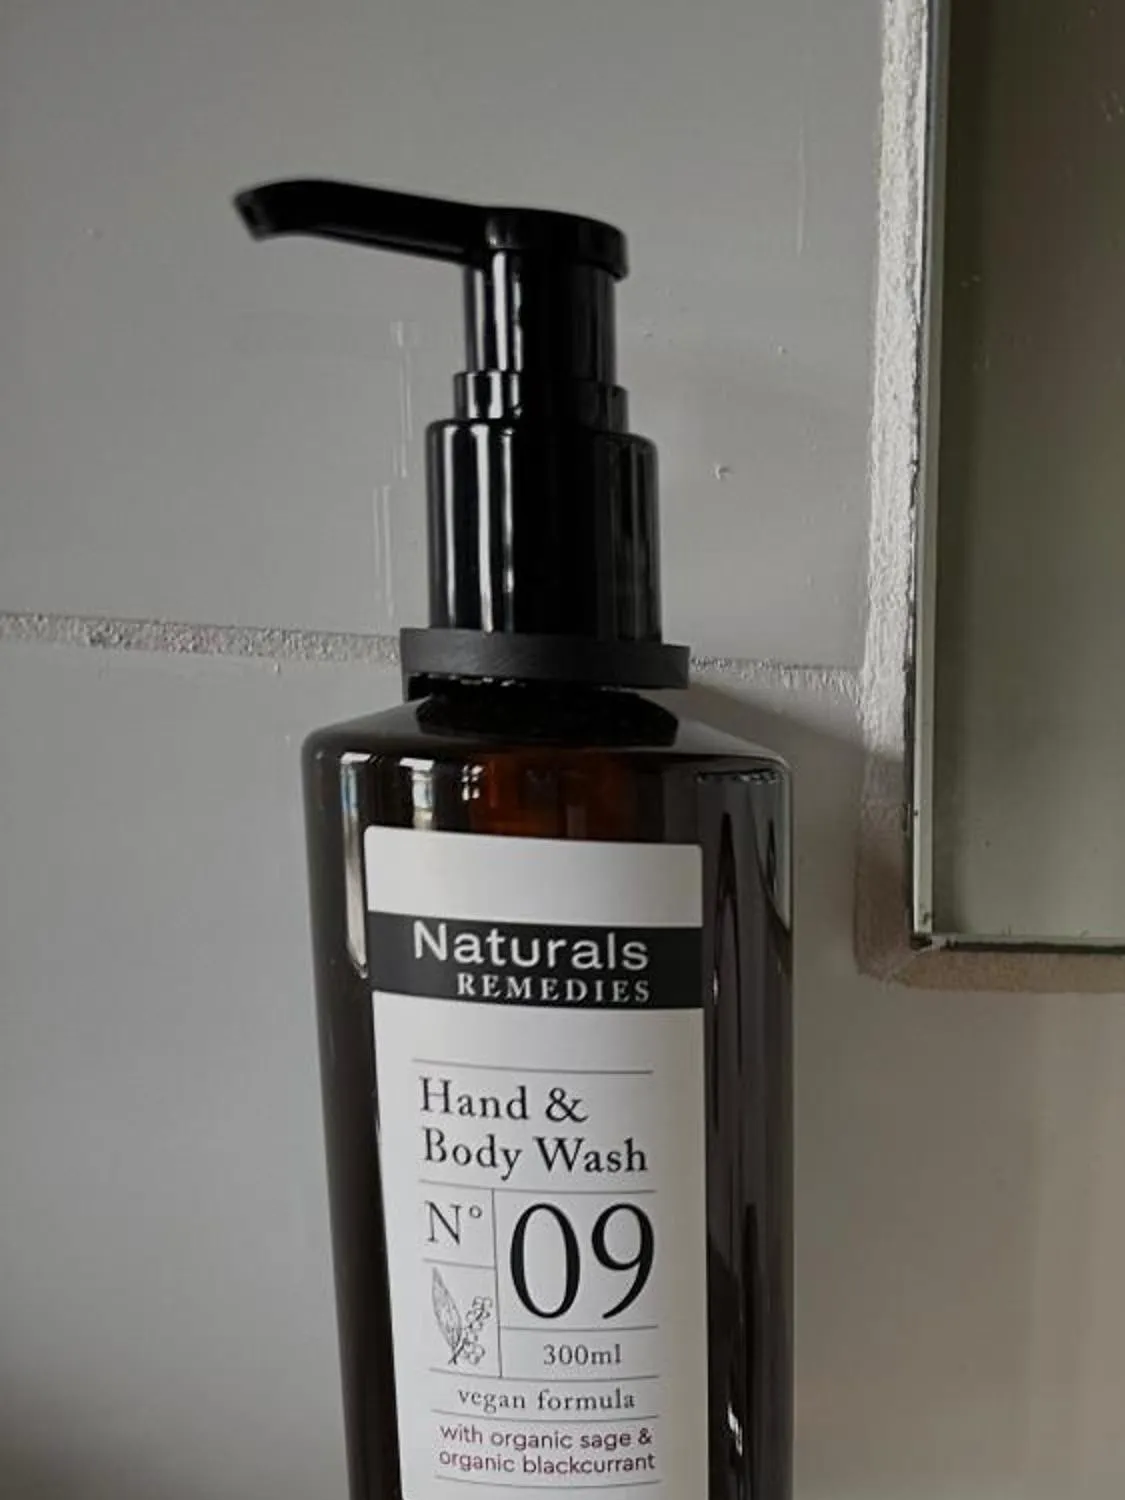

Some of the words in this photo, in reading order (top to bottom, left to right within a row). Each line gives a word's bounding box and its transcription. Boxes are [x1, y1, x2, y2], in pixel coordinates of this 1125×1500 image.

[413, 920, 650, 970] Naturals
[456, 972, 650, 1002] REMEDIES
[419, 1075, 531, 1121] Hand
[545, 1087, 589, 1123] &
[422, 1126, 523, 1181] Body
[532, 1137, 648, 1174] Wash
[509, 1203, 655, 1319] 09
[543, 1343, 622, 1366] 300ml
[457, 1388, 526, 1414] vegan
[537, 1386, 636, 1411] formula
[439, 1423, 483, 1445] with
[490, 1430, 573, 1452] organic
[580, 1431, 632, 1453] sage
[637, 1427, 653, 1446] &
[439, 1450, 515, 1474] organic
[522, 1453, 656, 1476] blackcurrant
